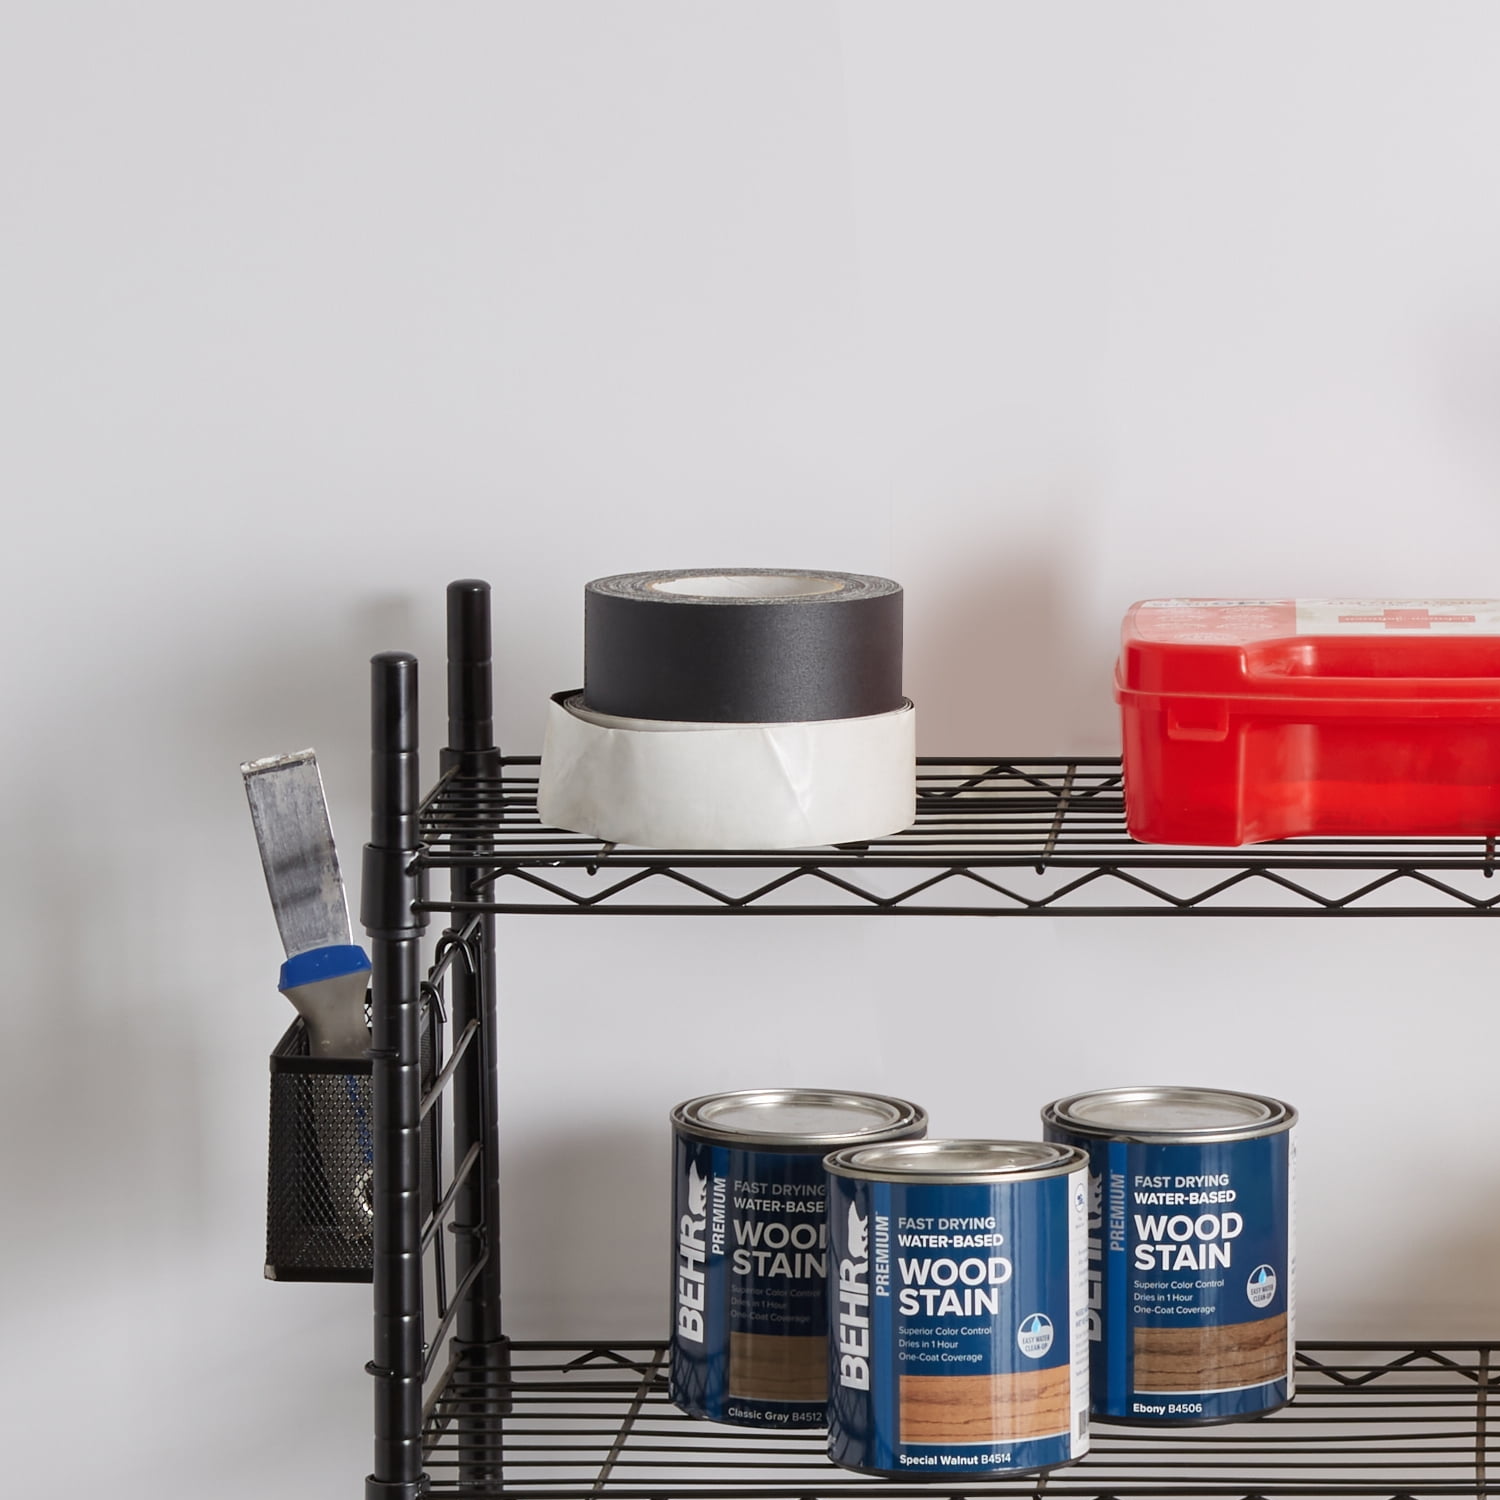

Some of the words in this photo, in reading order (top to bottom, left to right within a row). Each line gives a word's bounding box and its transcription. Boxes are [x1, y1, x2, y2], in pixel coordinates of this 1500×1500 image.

[734, 1180, 768, 1194] FAST
[1134, 1175, 1171, 1188] FAST
[1175, 1174, 1229, 1188] DRYING
[733, 1197, 825, 1213] WATER-BASE
[1134, 1190, 1236, 1205] WATER-BASED
[898, 1217, 934, 1230] FAST
[938, 1216, 996, 1230] DRYING
[1133, 1212, 1243, 1241] WOOD
[733, 1219, 827, 1249] WOO
[898, 1233, 1004, 1248] WATER-BASED
[1134, 1241, 1231, 1271] STAIN
[732, 1249, 827, 1279] STAIN
[898, 1256, 1013, 1286] WOOD
[678, 1213, 706, 1344] BEHR
[1134, 1279, 1168, 1290] Superior
[1170, 1280, 1193, 1289] Color
[1195, 1279, 1224, 1288] Control
[899, 1287, 999, 1317] STAIN
[1134, 1293, 1155, 1302] Dries
[1157, 1293, 1165, 1302] in
[1172, 1293, 1193, 1302] Hour
[1134, 1305, 1174, 1314] One-Coat
[1176, 1304, 1216, 1315] Coverage
[840, 1257, 869, 1392] BEHR
[898, 1326, 933, 1337] Superior
[935, 1326, 959, 1336] Color
[960, 1326, 992, 1336] Control
[898, 1339, 920, 1349] Dries
[921, 1340, 930, 1349] in
[937, 1340, 959, 1349] Hour
[898, 1352, 940, 1362] One-Coat
[941, 1353, 983, 1363] Coverage
[728, 1407, 762, 1420] Classic
[764, 1411, 789, 1423] Gray
[792, 1411, 822, 1422] B4512
[1133, 1403, 1165, 1415] Ebony
[1168, 1404, 1202, 1413] B4506
[899, 1454, 938, 1466] Special
[940, 1455, 978, 1465] Walnut
[981, 1454, 1011, 1464] B4514
